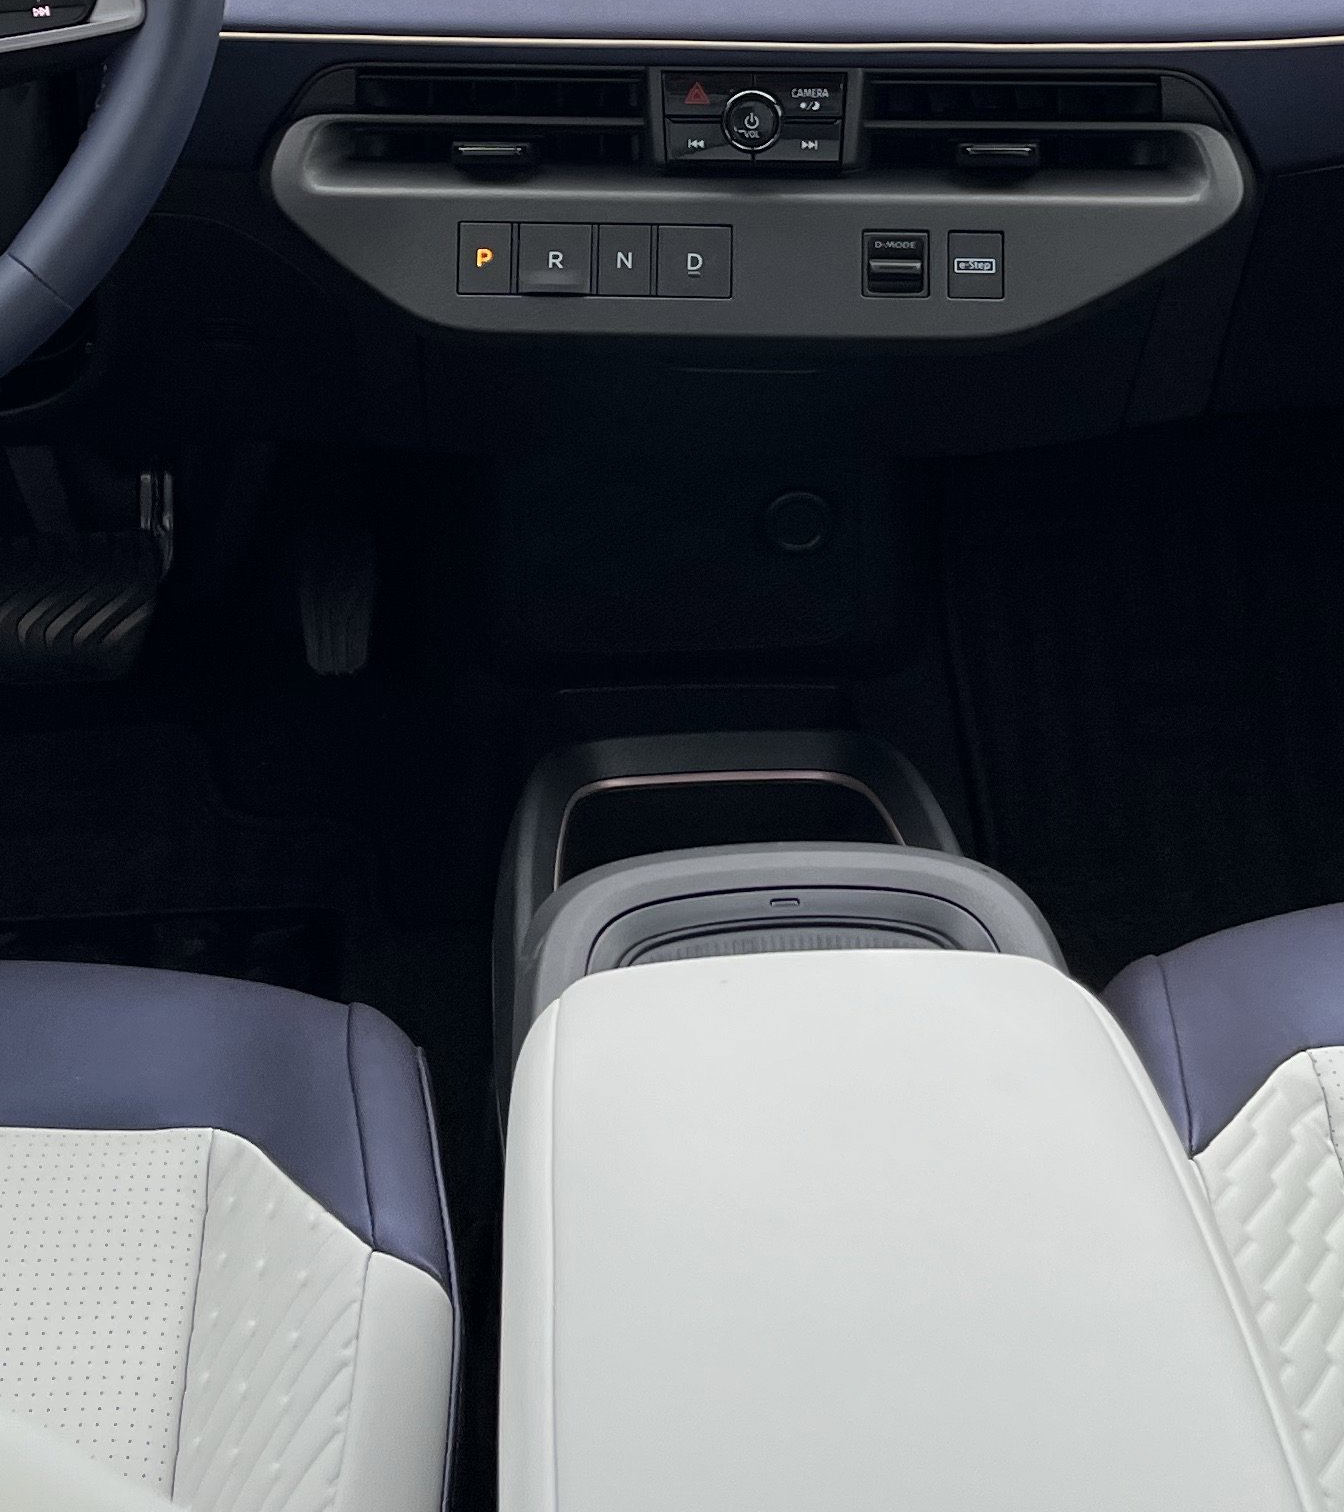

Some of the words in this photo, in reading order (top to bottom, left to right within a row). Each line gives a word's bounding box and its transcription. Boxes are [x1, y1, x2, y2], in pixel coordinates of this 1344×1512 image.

[791, 89, 829, 98] CAMERA
[744, 130, 760, 139] VOL
[475, 247, 494, 268] P
[548, 251, 564, 269] R
[616, 251, 633, 269] N
[687, 252, 703, 271] D
[958, 260, 992, 271] e-Step
